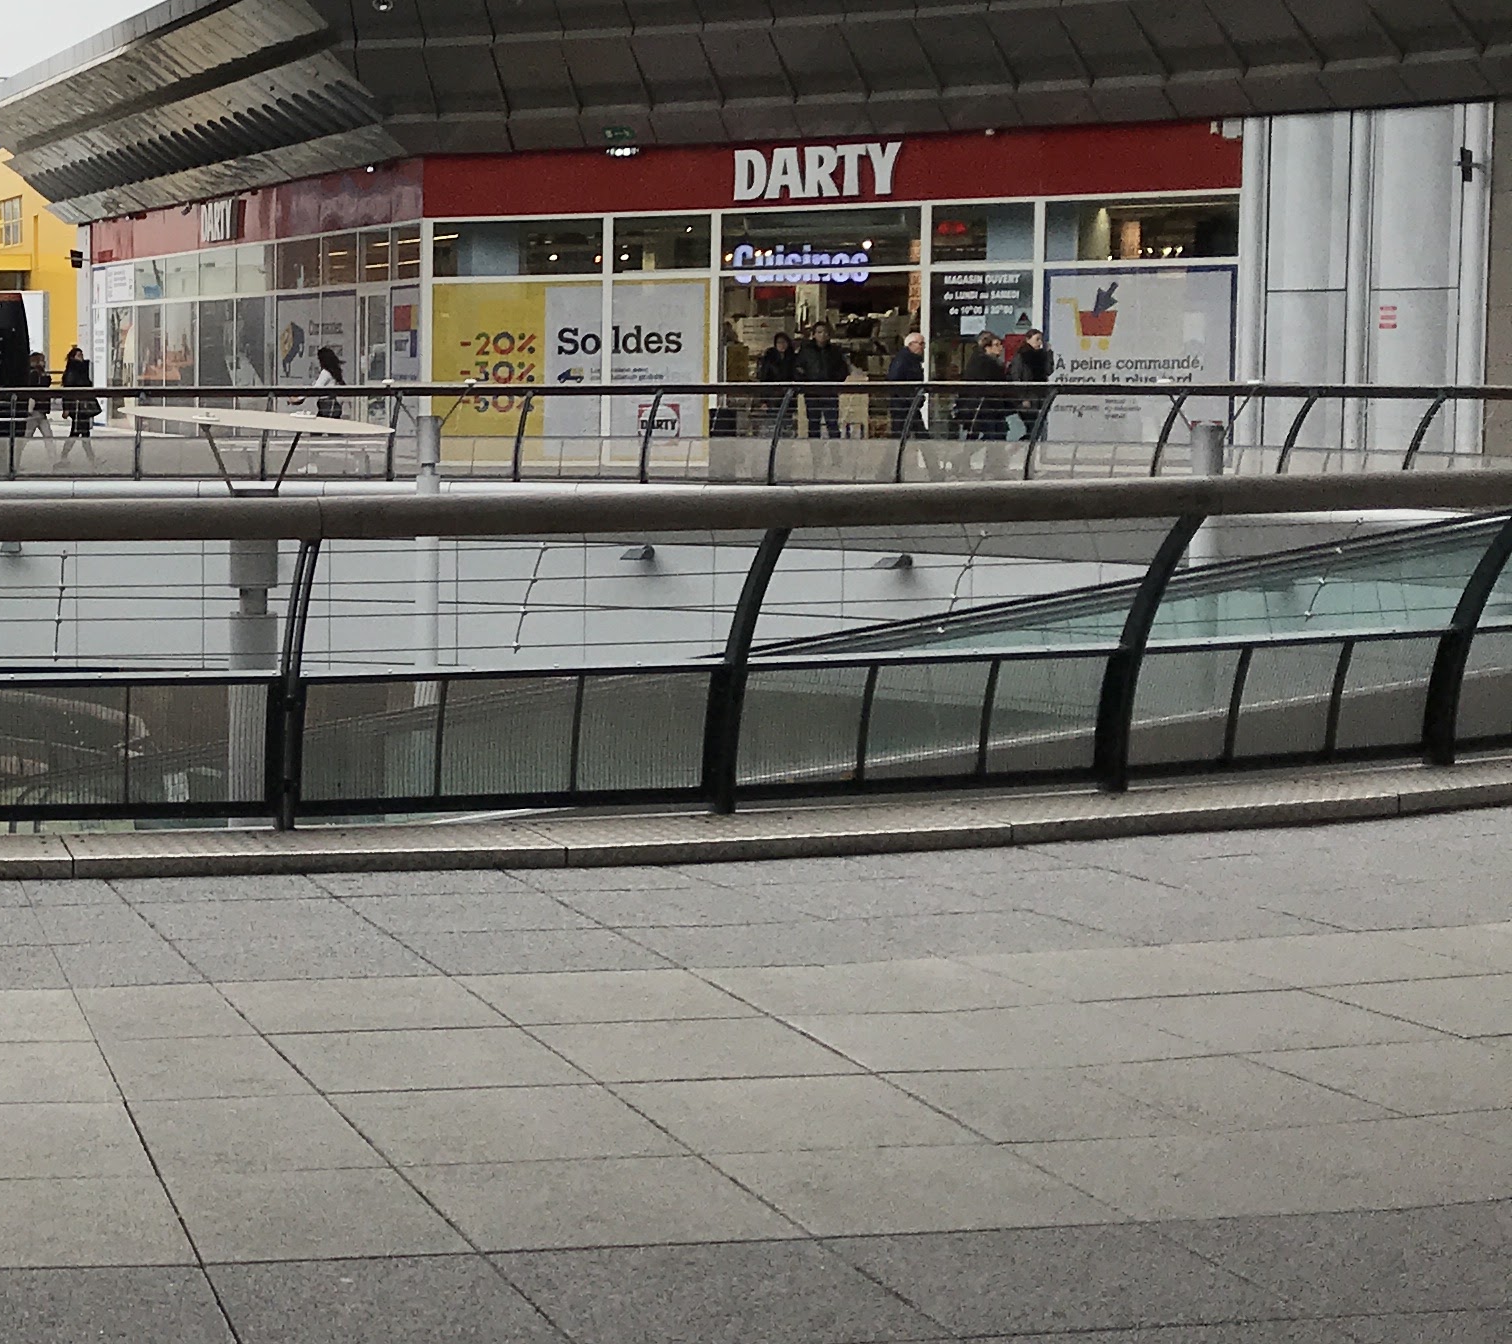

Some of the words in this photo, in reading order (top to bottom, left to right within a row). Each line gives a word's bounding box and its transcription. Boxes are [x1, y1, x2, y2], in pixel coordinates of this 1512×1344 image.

[733, 141, 903, 201] DARTY
[200, 199, 233, 242] DARTY
[732, 243, 870, 284] Cuisines
[944, 274, 983, 285] MAGASIN
[984, 274, 1021, 285] OUVERT
[990, 289, 1020, 299] SAMEDI
[460, 331, 537, 356] -20%
[557, 325, 683, 356] Soldes
[460, 361, 536, 384] -30%
[1055, 353, 1066, 370] À
[1070, 356, 1112, 372] peine
[1115, 355, 1204, 371] commandé,
